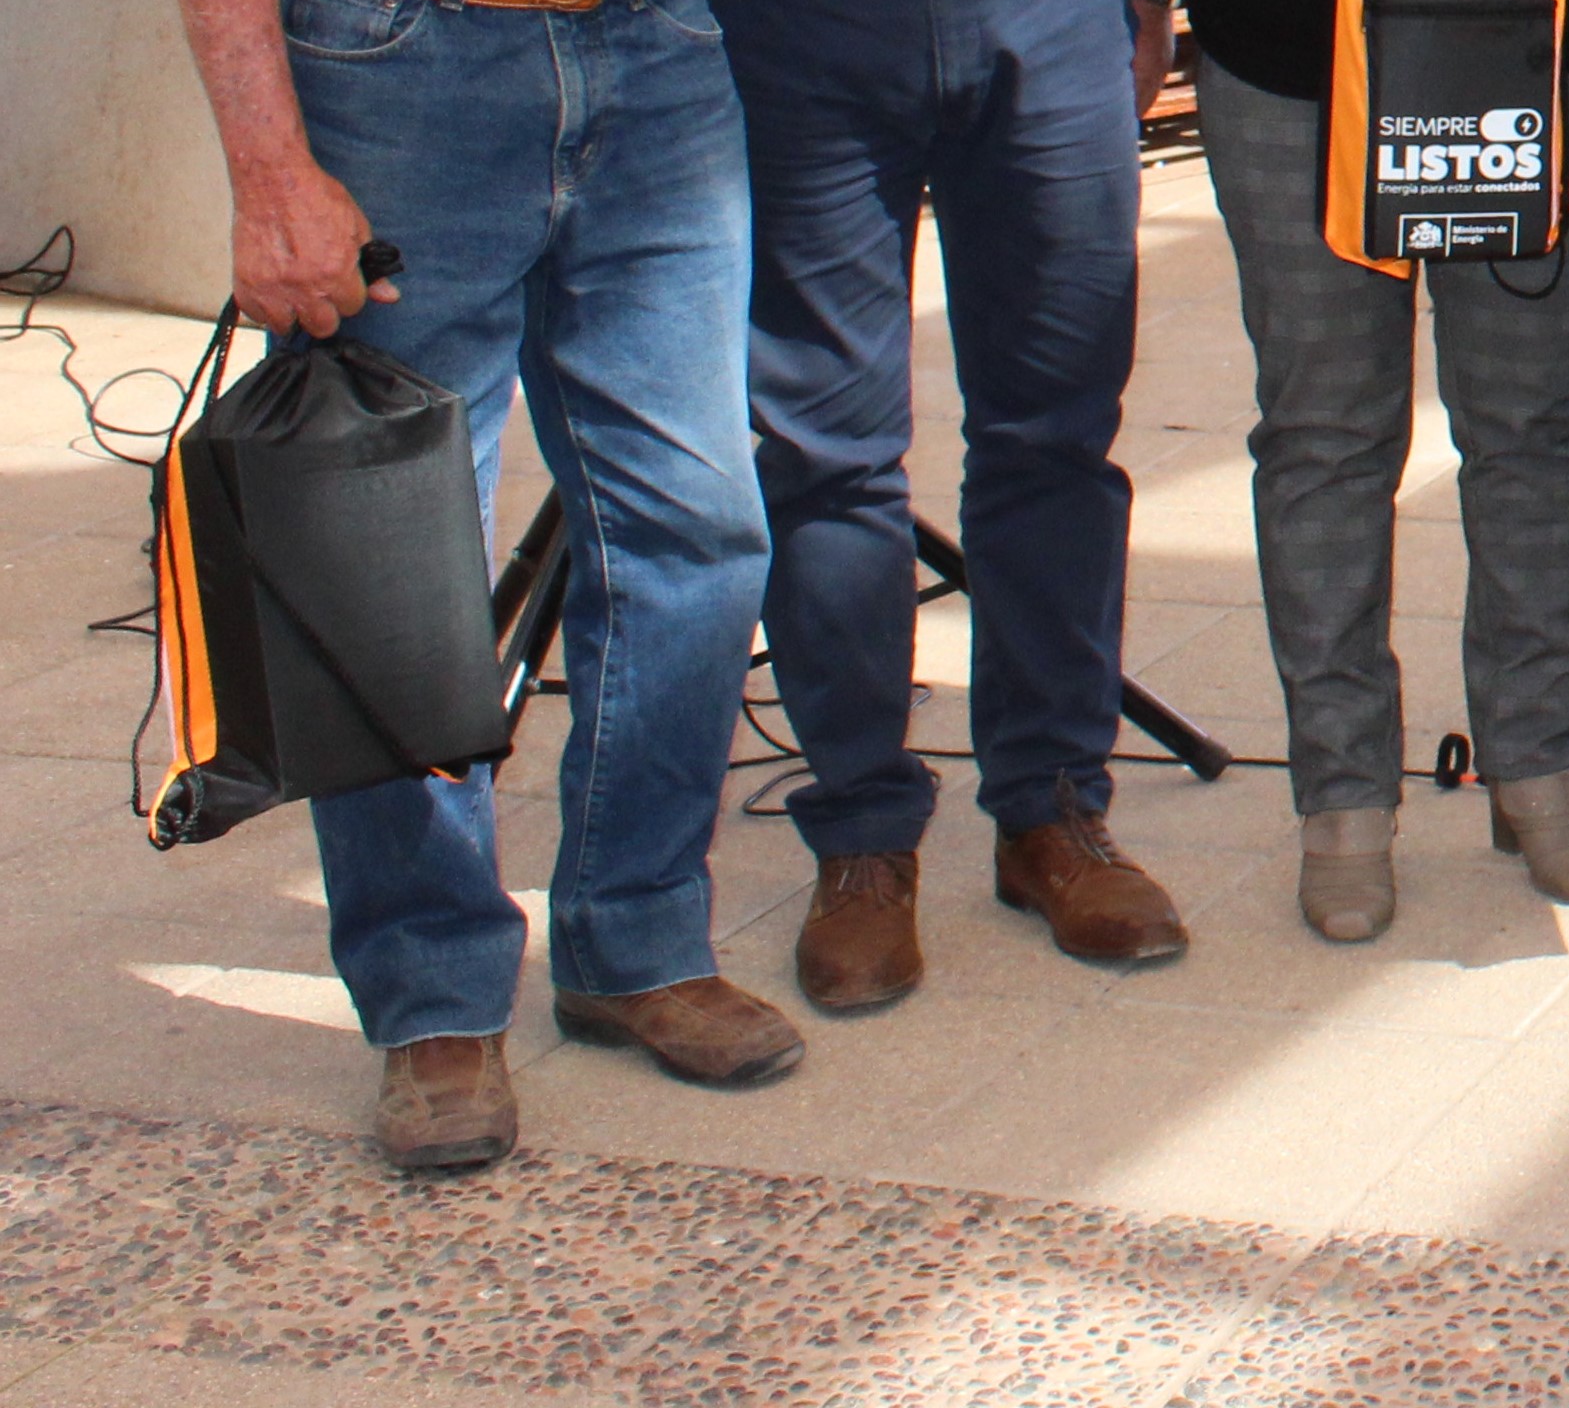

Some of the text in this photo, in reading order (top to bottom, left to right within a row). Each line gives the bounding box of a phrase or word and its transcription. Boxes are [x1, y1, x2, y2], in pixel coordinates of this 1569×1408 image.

[1379, 116, 1478, 137] SIEMPRE
[1377, 142, 1543, 181] LISTOS
[1377, 180, 1541, 196] Energía para estar conectados
[1452, 224, 1508, 235] Ministerio de
